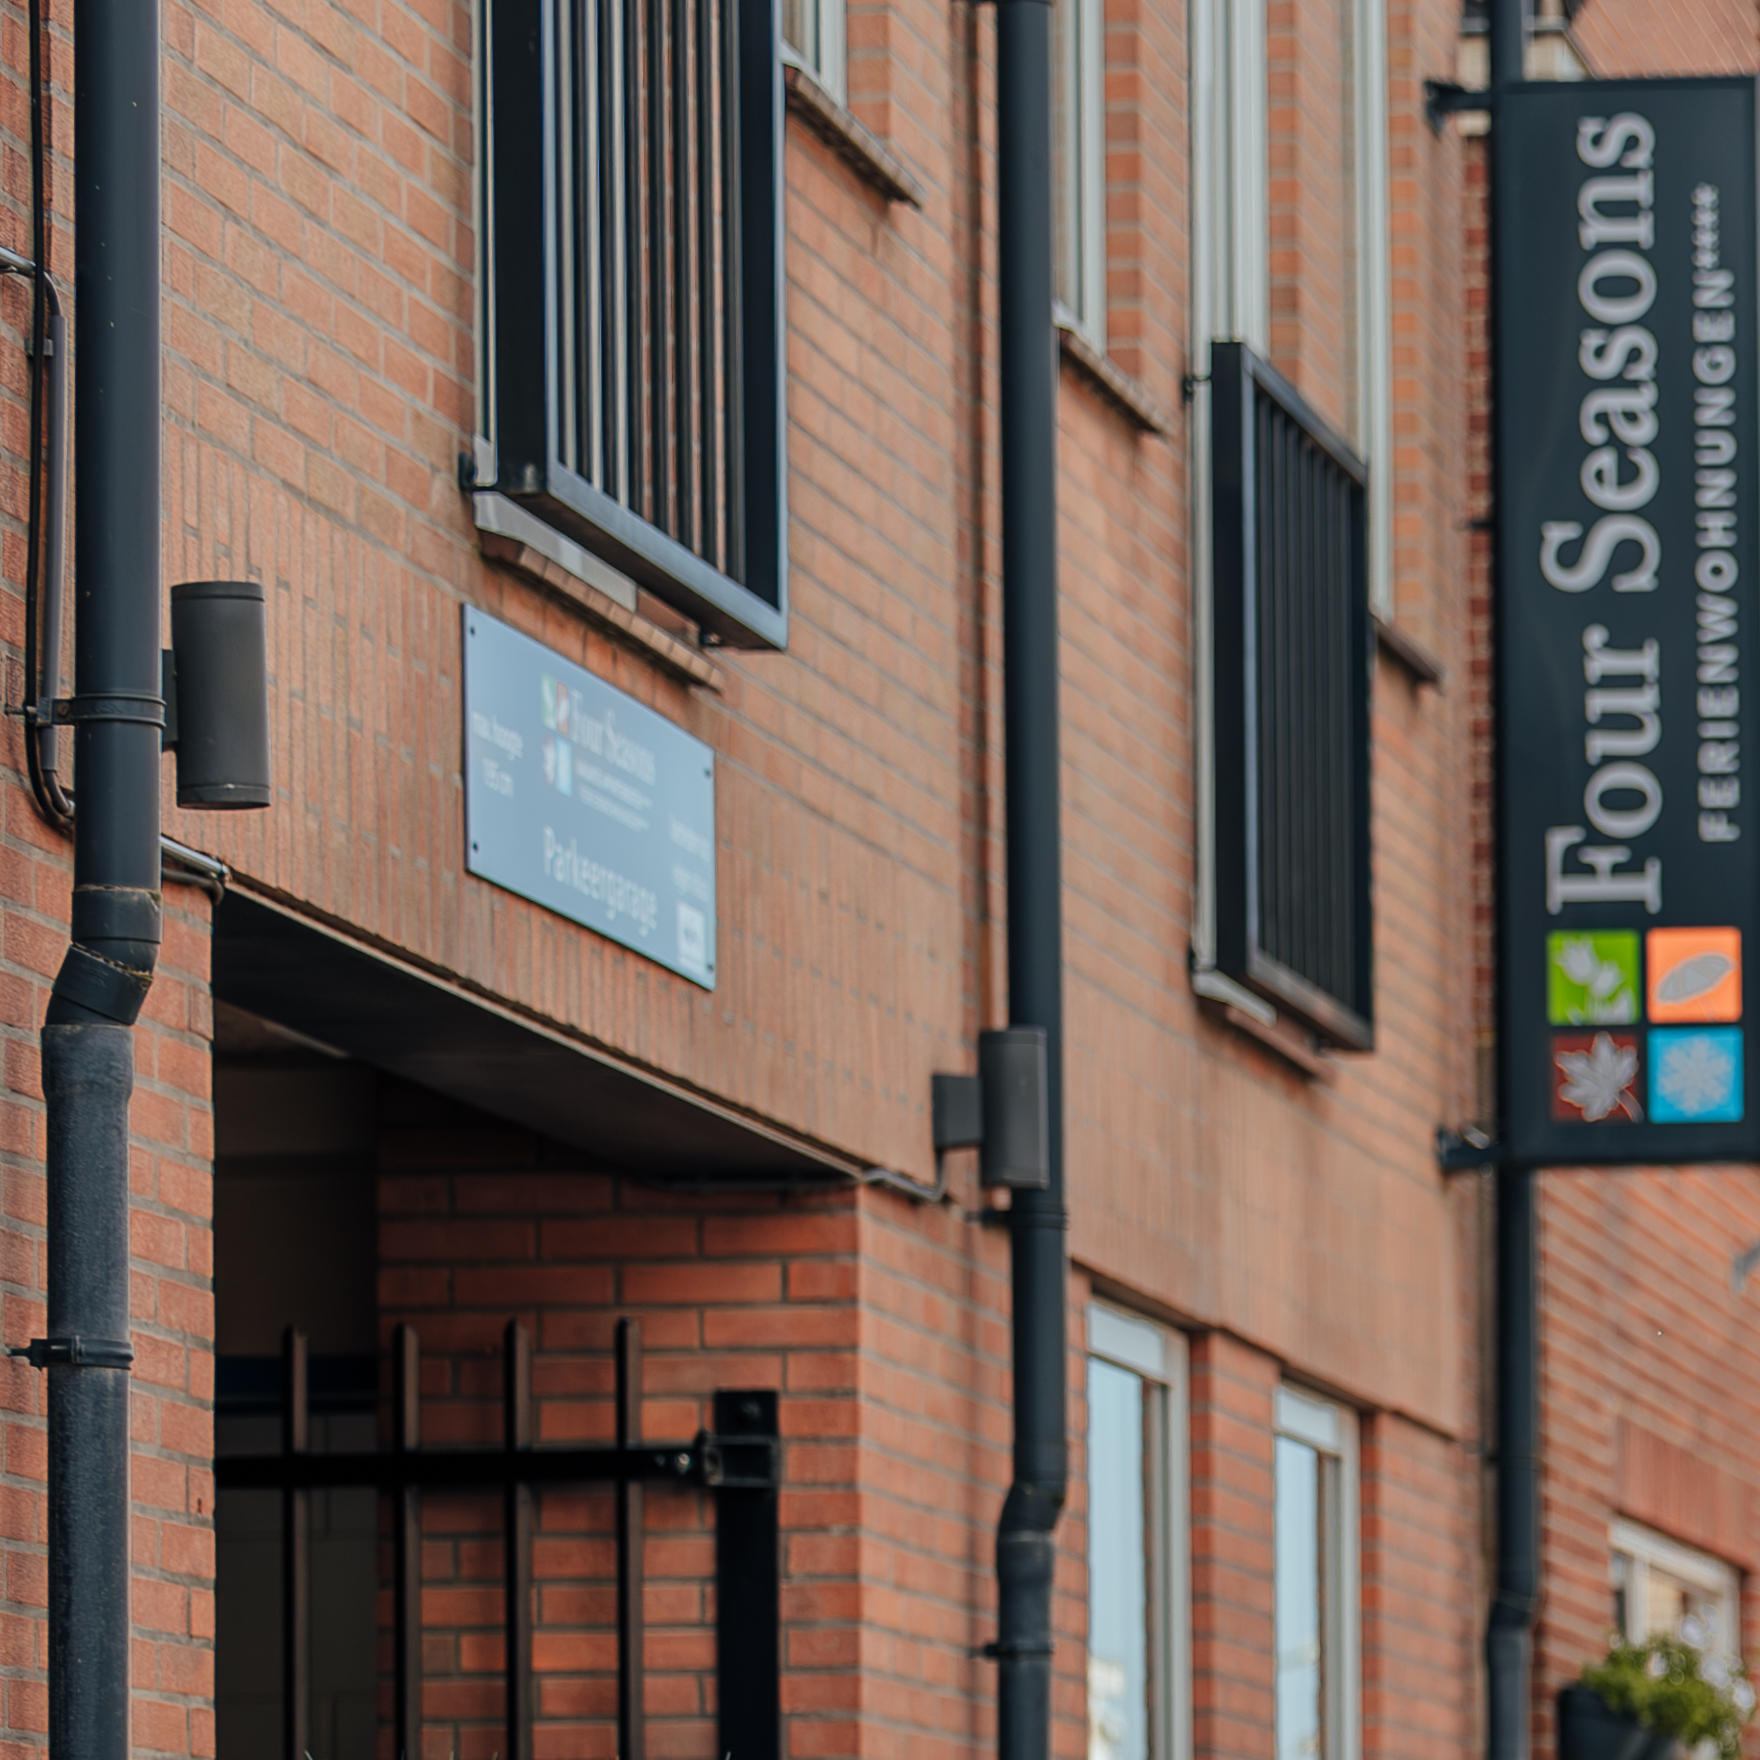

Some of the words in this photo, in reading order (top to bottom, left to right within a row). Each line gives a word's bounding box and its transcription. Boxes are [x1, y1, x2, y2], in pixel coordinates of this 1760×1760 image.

[1540, 110, 1662, 595] Seasons
[1694, 267, 1742, 843] FERIENWOHNUNGEN
[543, 824, 659, 938] Parkeergarage
[1545, 624, 1663, 915] Four
